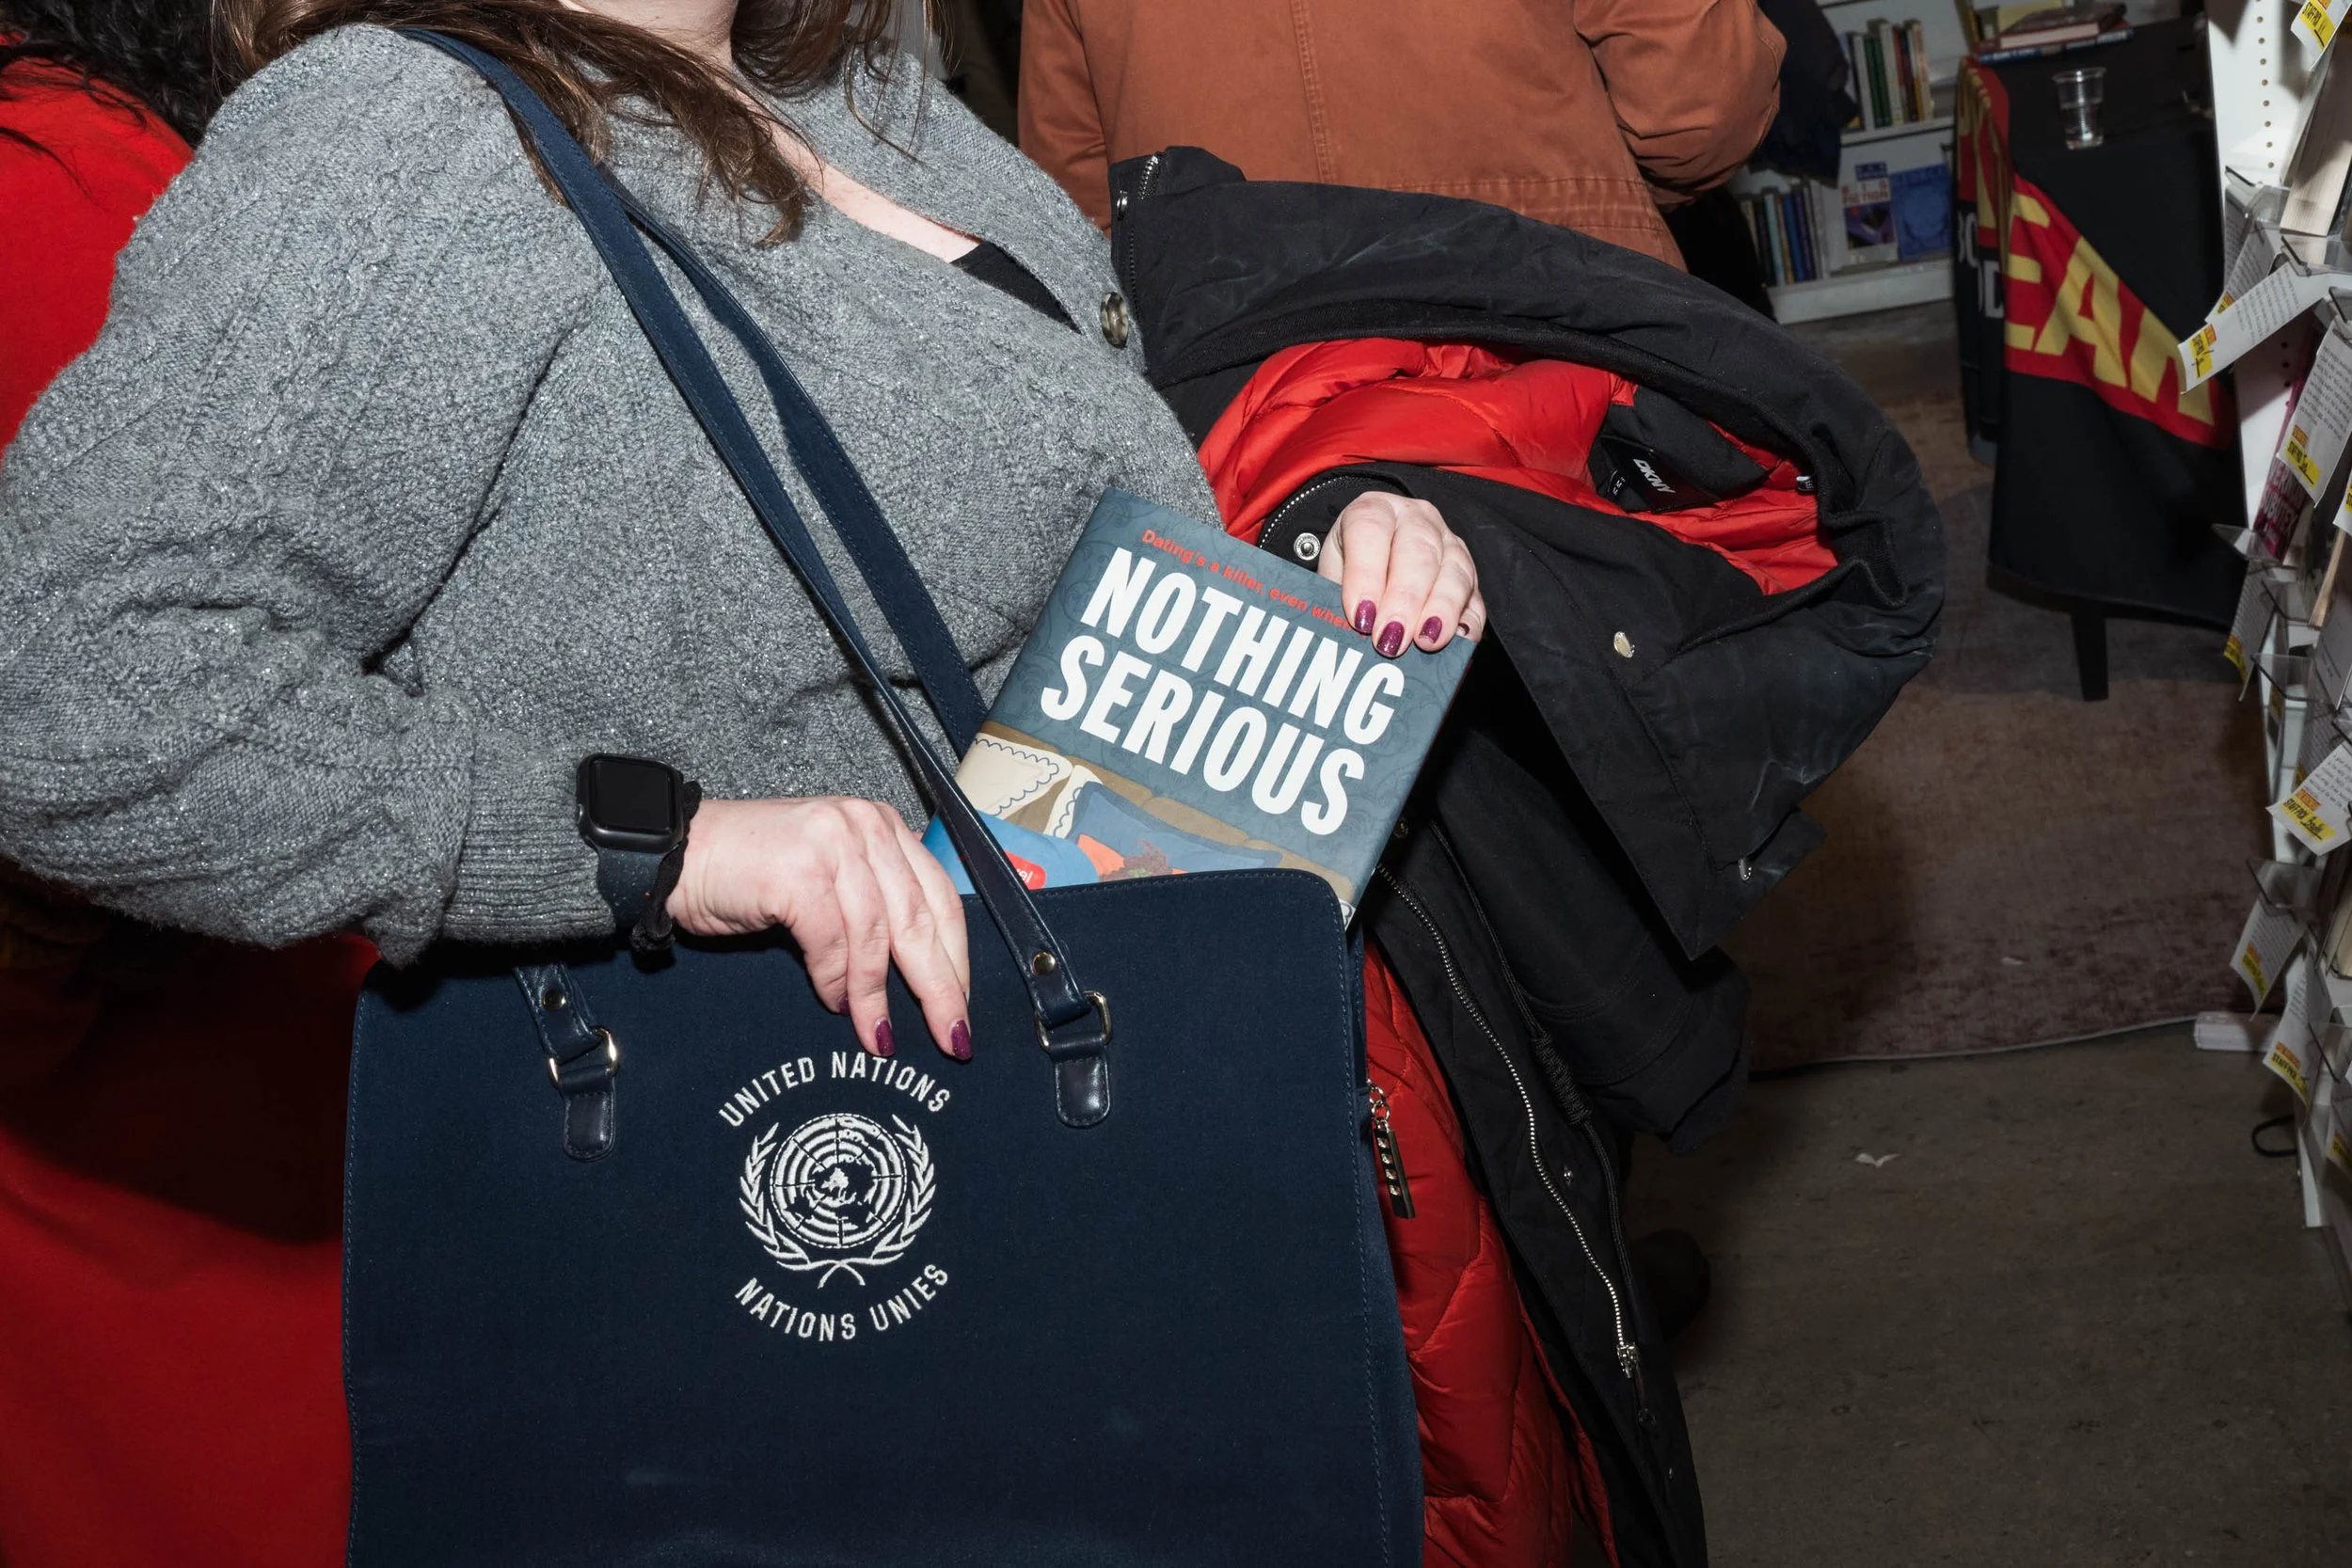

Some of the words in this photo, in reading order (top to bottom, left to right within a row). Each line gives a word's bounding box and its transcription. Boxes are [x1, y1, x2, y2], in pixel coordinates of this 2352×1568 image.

[1632, 458, 1677, 494] DKNY
[1141, 529, 1206, 567] Dating's
[1209, 562, 1220, 573] a
[1222, 566, 1265, 595] killer,
[1270, 587, 1307, 611] even
[1080, 546, 1405, 745] NOTHING
[1040, 635, 1365, 836] SERIOUS
[718, 1056, 816, 1127] UNITED
[831, 1051, 950, 1113] NATIONS
[734, 1277, 856, 1341] NATIONS
[868, 1263, 948, 1332] UNIES
